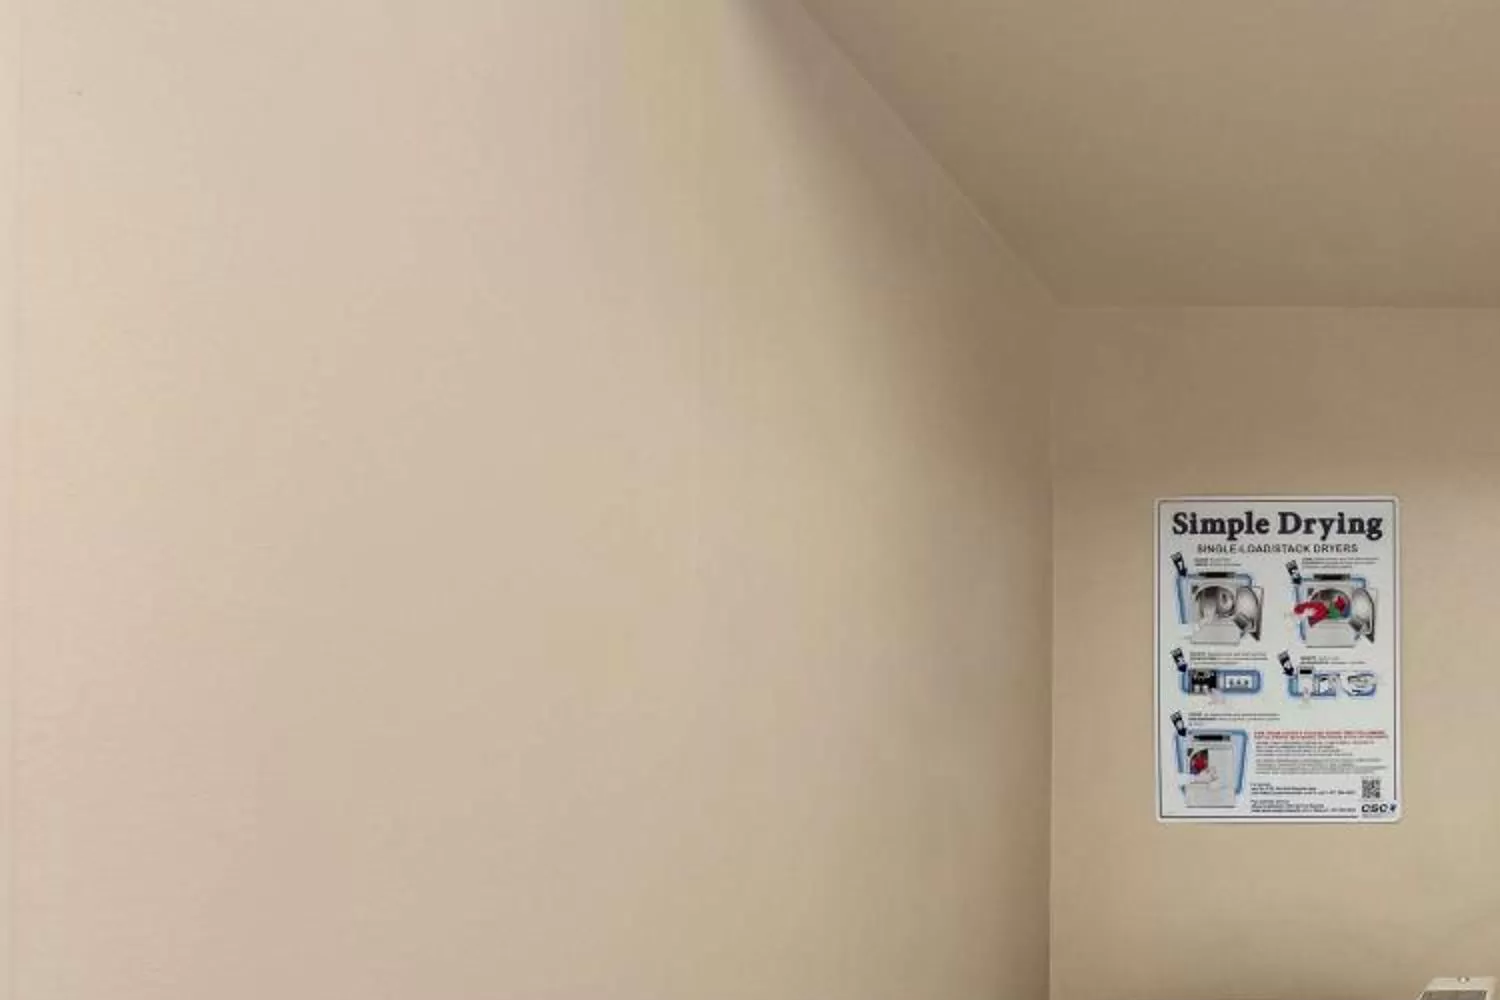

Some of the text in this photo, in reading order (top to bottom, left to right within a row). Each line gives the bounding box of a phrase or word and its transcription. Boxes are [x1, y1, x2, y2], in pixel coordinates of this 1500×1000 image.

[1171, 510, 1384, 541] Simple Drying
[1313, 543, 1360, 554] DRYERS
